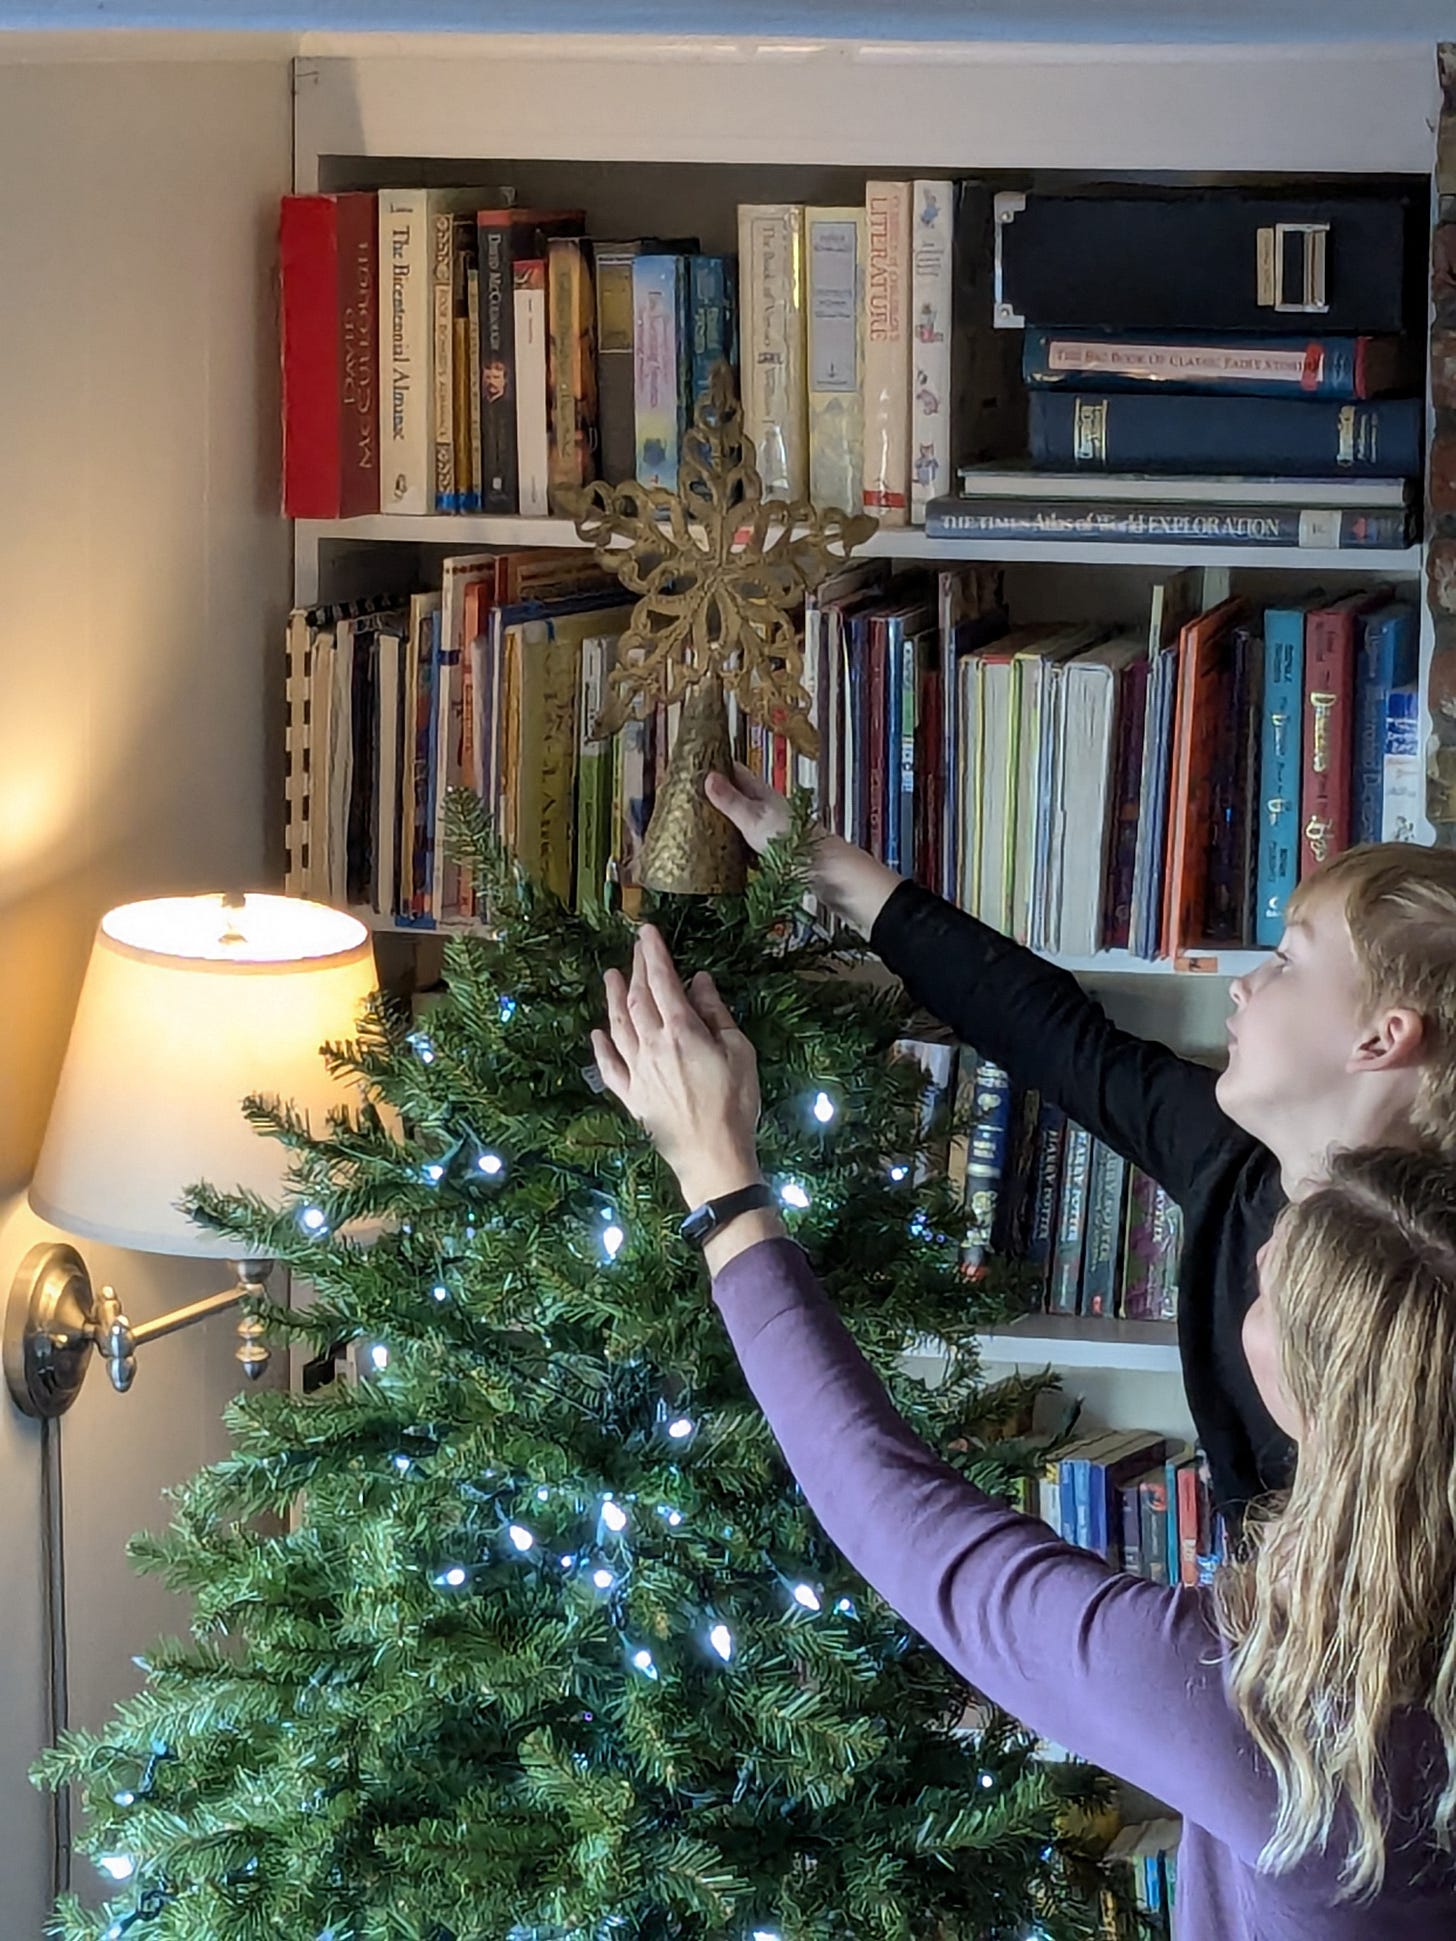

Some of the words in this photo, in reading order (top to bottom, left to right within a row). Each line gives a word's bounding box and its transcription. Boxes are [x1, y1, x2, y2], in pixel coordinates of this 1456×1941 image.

[393, 227, 411, 259] The
[870, 197, 888, 342] LITERATURE
[393, 264, 411, 362] Bicentennial
[344, 308, 355, 403] DAVID
[393, 367, 411, 441] Almanac
[942, 514, 977, 530] THE
[1034, 513, 1071, 531] Atlas
[1148, 515, 1280, 537] EXPLORATION
[1045, 1130, 1059, 1185] HARRY
[1073, 1131, 1087, 1186] HARRY
[1038, 1187, 1053, 1240] POTTER
[1067, 1189, 1081, 1242] POTTER
